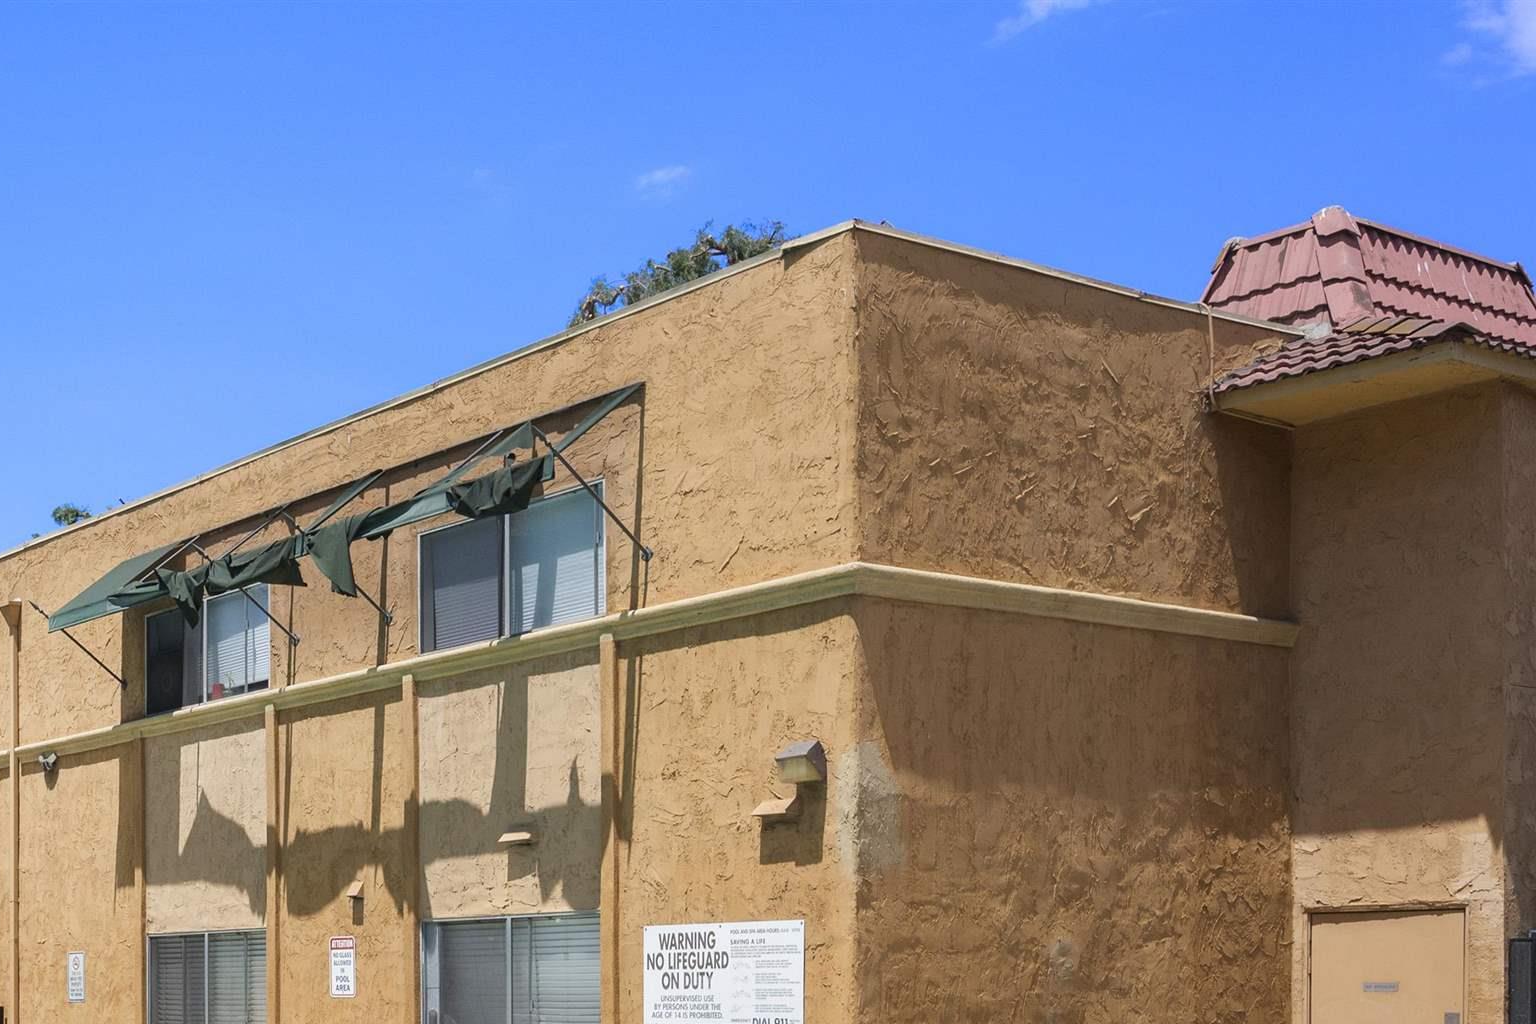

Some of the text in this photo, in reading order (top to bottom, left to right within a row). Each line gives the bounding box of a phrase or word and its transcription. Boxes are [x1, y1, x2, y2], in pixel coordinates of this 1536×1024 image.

[658, 931, 716, 950] WARNING
[646, 952, 664, 970] NO
[668, 951, 729, 970] LIFEGUARD
[335, 975, 350, 983] POOL
[661, 972, 714, 990] ON DUTY
[660, 994, 715, 1002] UNSUPERVISED USE
[653, 1003, 721, 1011] BY PERSONS UNDER THE
